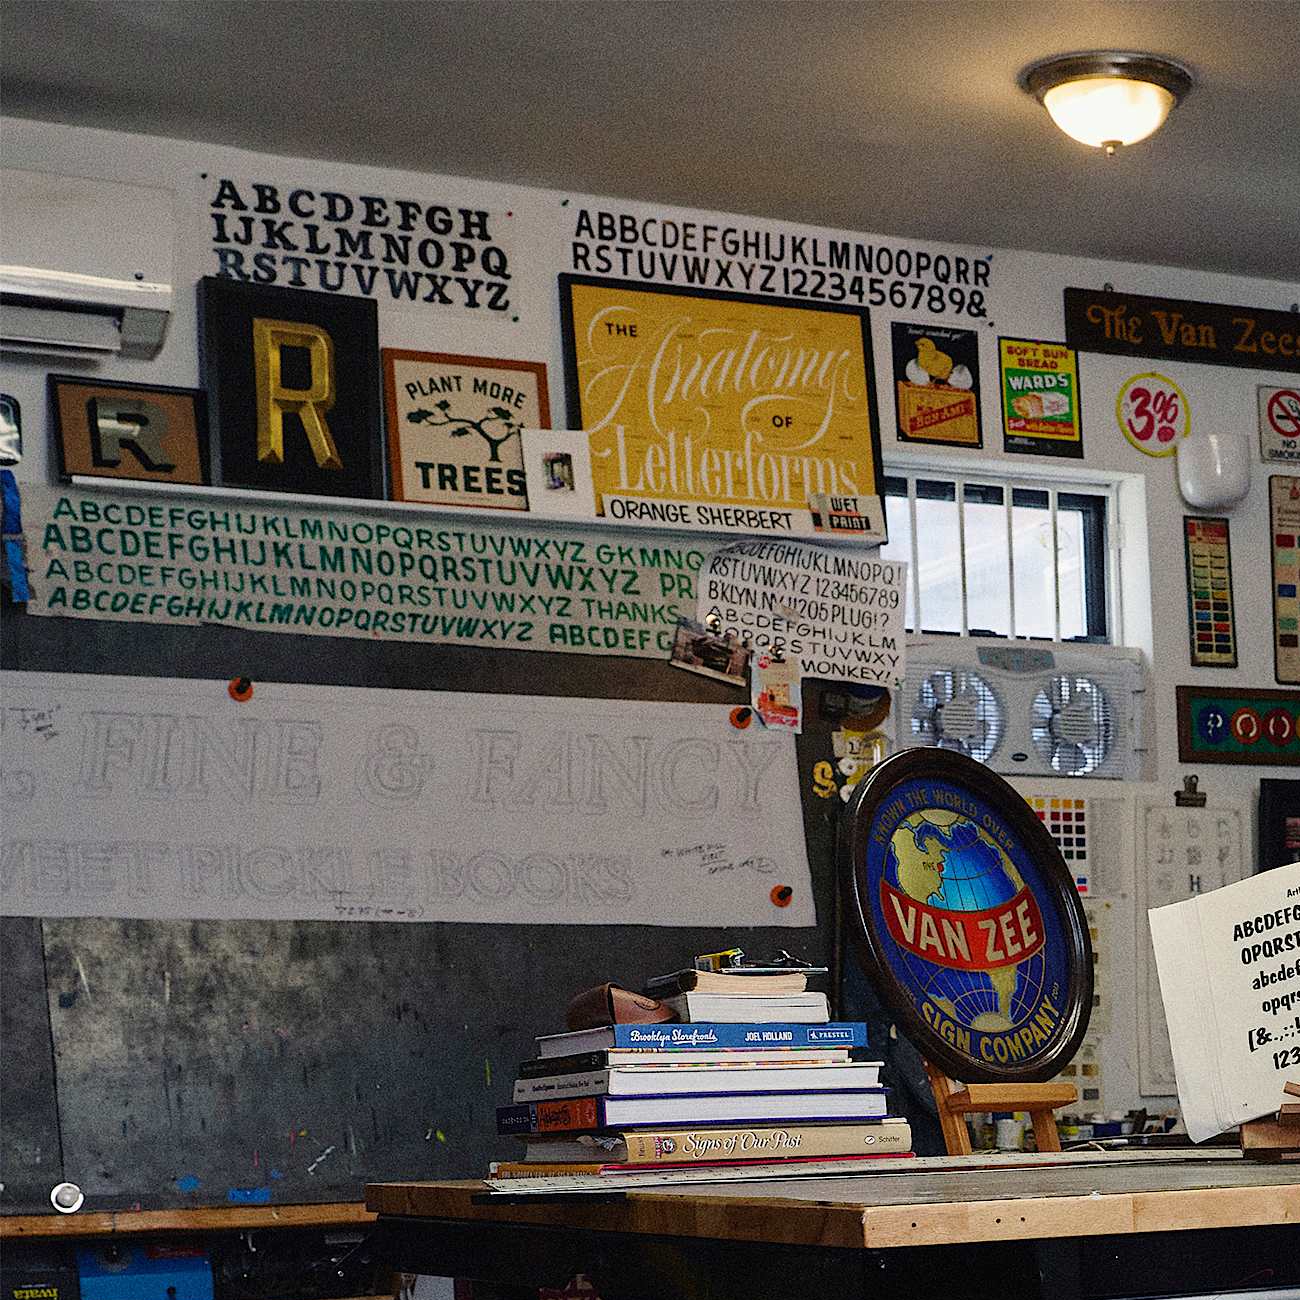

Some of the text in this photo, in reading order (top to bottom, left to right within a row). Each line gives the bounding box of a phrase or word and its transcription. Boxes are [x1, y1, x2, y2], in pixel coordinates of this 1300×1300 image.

[210, 179, 492, 241] ABCDEFGH
[210, 213, 512, 280] IJKLMNOPQ
[575, 209, 991, 288] ABBCDEFGHIJKLMNOOPQRR
[212, 248, 511, 311] RSTUVWXYZ
[605, 322, 638, 338] THE
[1087, 303, 1143, 344] The
[1151, 310, 1217, 349] Van
[253, 317, 342, 470] R
[405, 375, 527, 410] PLANT MORE
[1008, 373, 1070, 391] WARDS
[87, 396, 176, 473] R
[772, 414, 793, 429] OF
[415, 461, 527, 497] TREES
[591, 422, 862, 503] Letterforms
[610, 498, 793, 531] ORANGE SHERBERT
[830, 496, 859, 512] WET
[580, 599, 681, 625] THANKS
[80, 710, 323, 806] FINE
[358, 722, 435, 808] &
[472, 726, 785, 820] FANCY
[184, 842, 413, 905] PICKLE
[426, 848, 634, 908] BOOKS
[888, 892, 1038, 963] VAN ZEE
[630, 1029, 850, 1047] Brooklyn Storefronts JOEL HOLLAND PRESTEL
[921, 993, 1061, 1064] SIGN COMPANY
[683, 1131, 722, 1159] Signs
[723, 1132, 738, 1154] of
[740, 1132, 771, 1152] Our
[769, 1130, 802, 1152] Past
